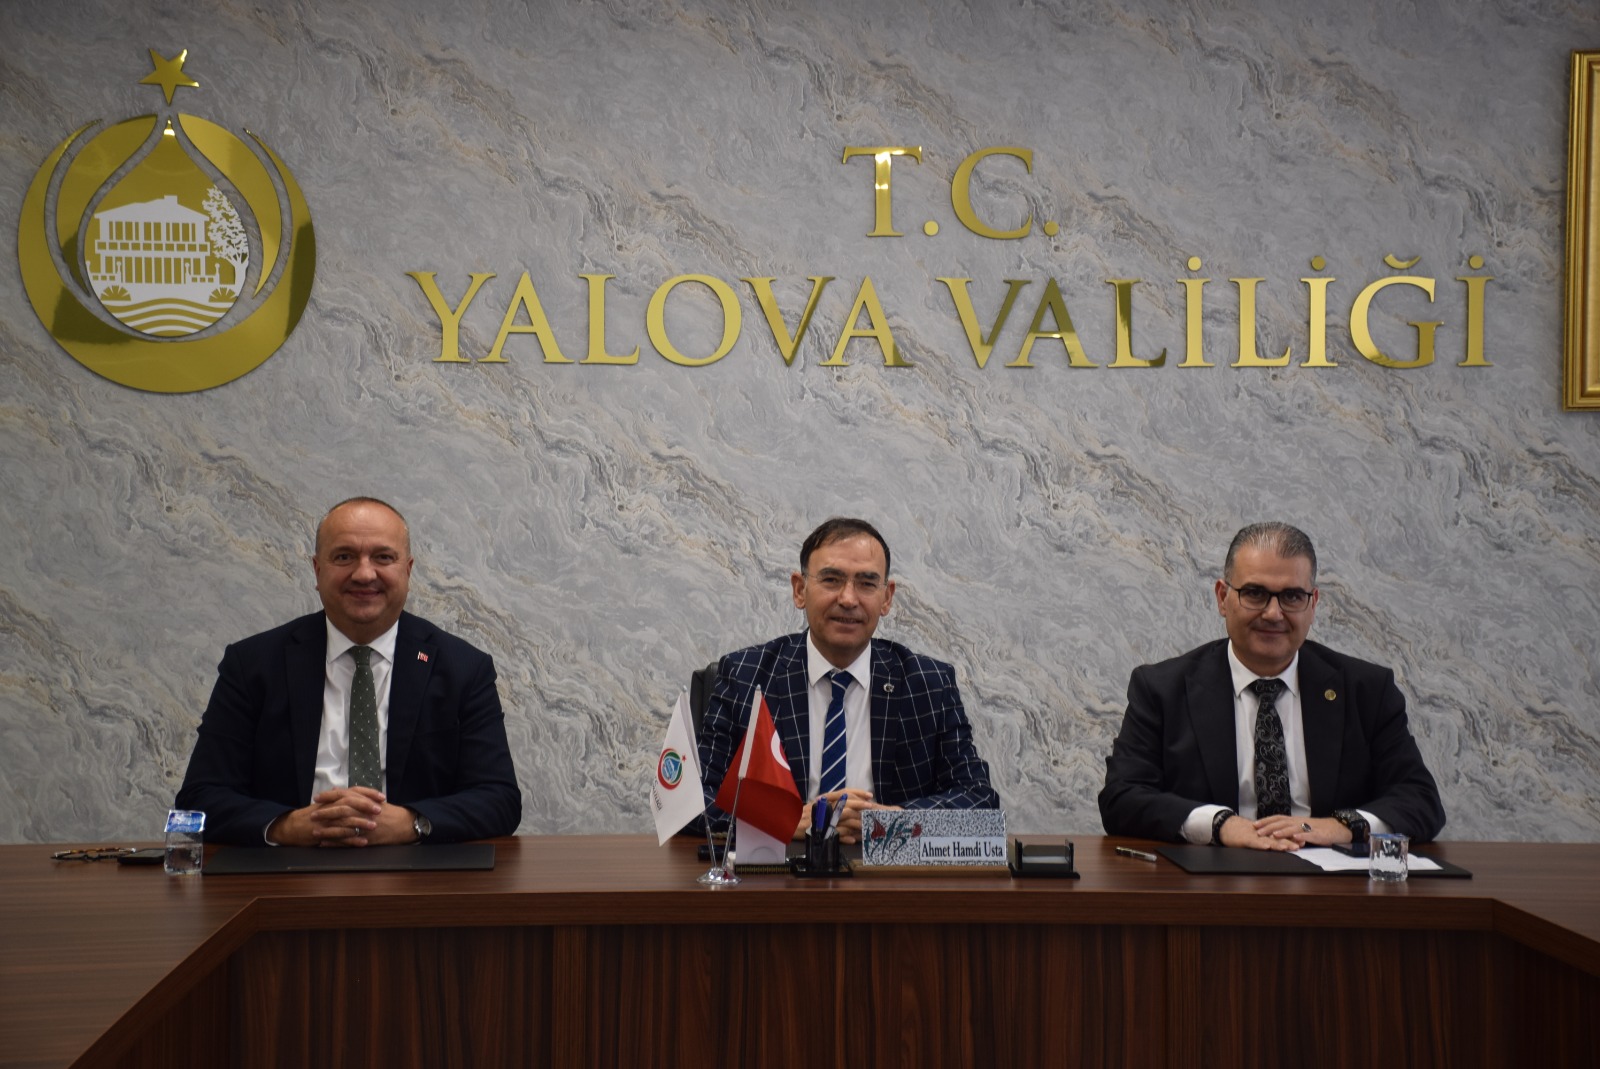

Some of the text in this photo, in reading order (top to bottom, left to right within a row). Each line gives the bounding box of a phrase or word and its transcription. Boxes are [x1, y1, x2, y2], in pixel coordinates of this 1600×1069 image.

[842, 146, 1060, 240] T.C.
[404, 253, 1495, 369] YALOVA VALİLİĞİ
[921, 841, 1004, 858] Ahmet Hamdi Usta
